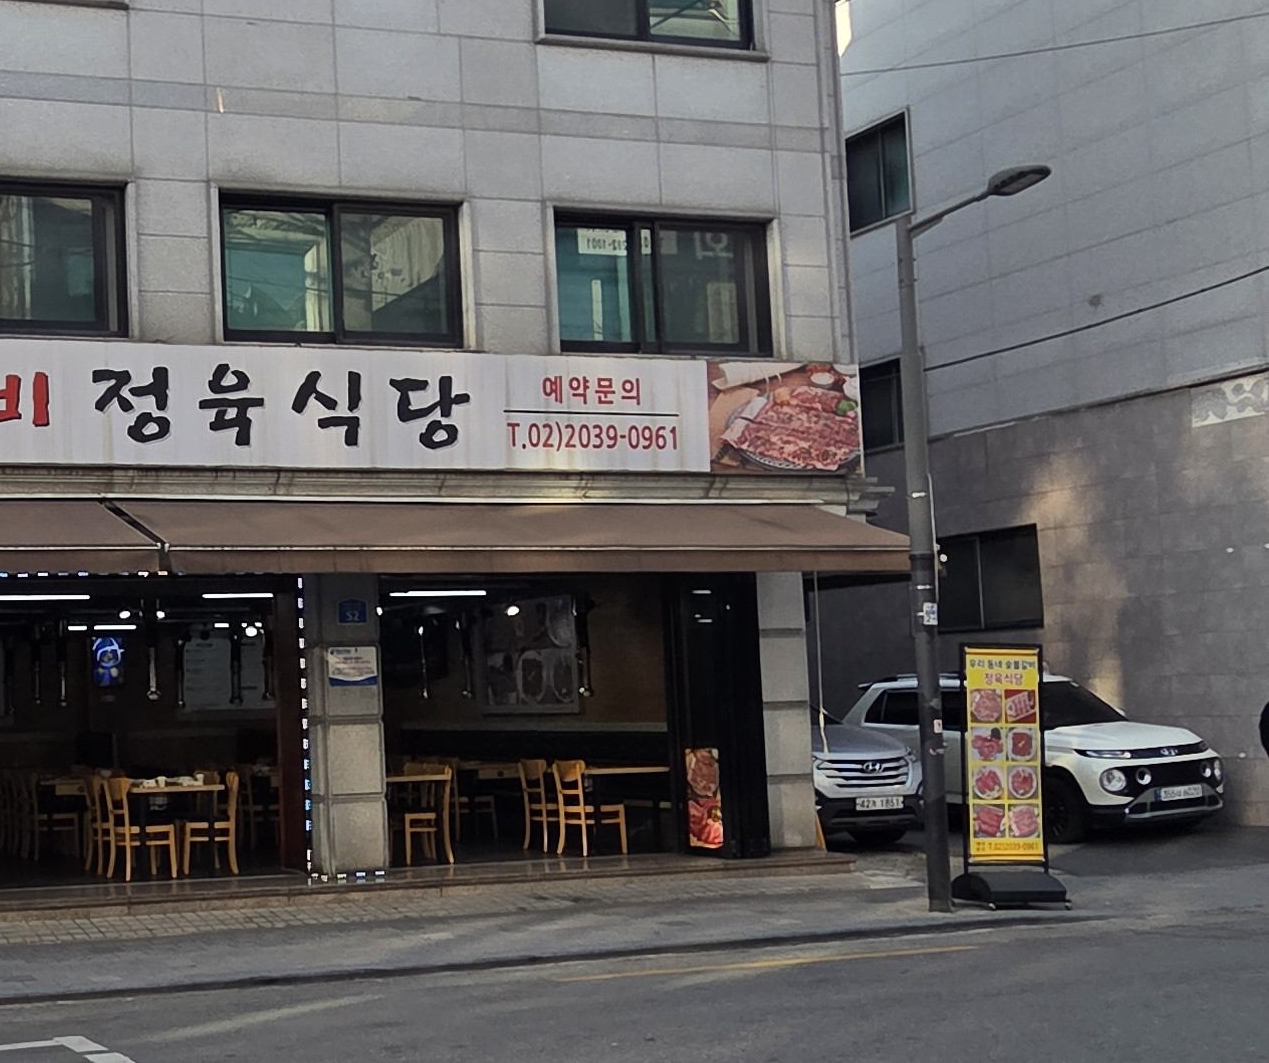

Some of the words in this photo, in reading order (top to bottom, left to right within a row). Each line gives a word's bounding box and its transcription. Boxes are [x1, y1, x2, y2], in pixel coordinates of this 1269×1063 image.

[92, 363, 471, 451] 정육식당
[541, 374, 643, 408] 예약문의
[506, 421, 679, 453] T.02)2039-0961
[984, 673, 1024, 686] 정육식당
